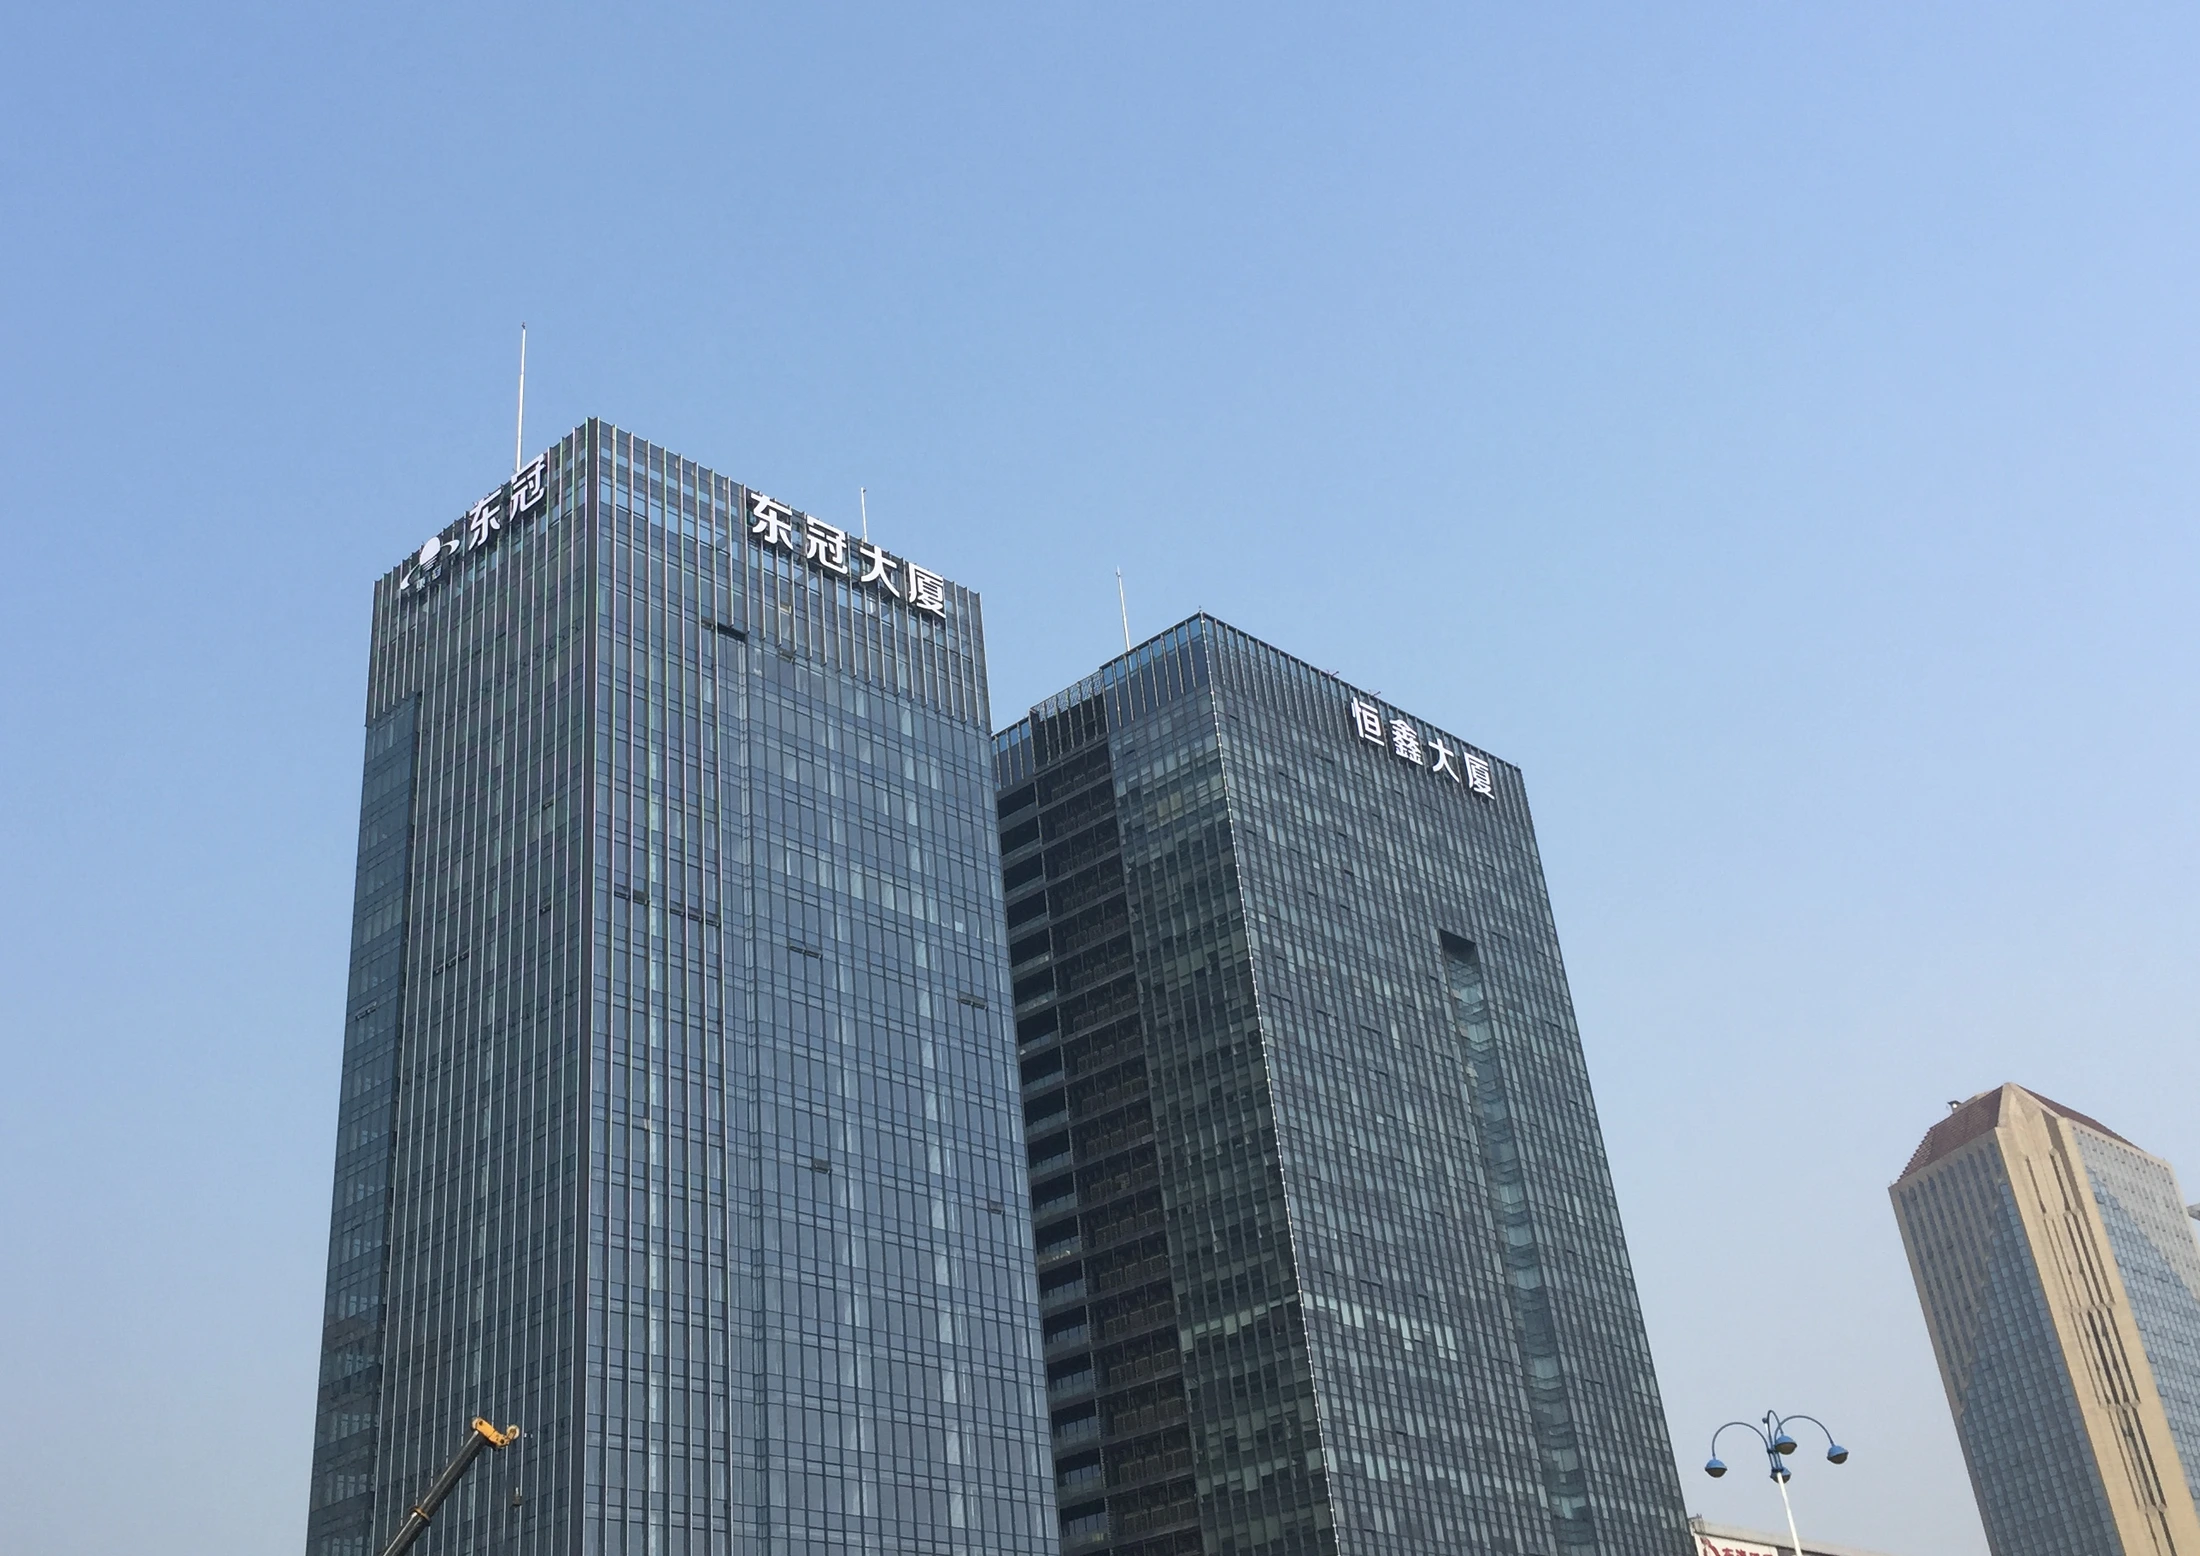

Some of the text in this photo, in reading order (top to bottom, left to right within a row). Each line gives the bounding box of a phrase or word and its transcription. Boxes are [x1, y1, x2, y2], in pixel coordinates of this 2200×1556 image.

[468, 453, 546, 551] 东冠
[751, 493, 946, 619] 东冠大厦
[1351, 696, 1495, 800] 恒鑫大厦
